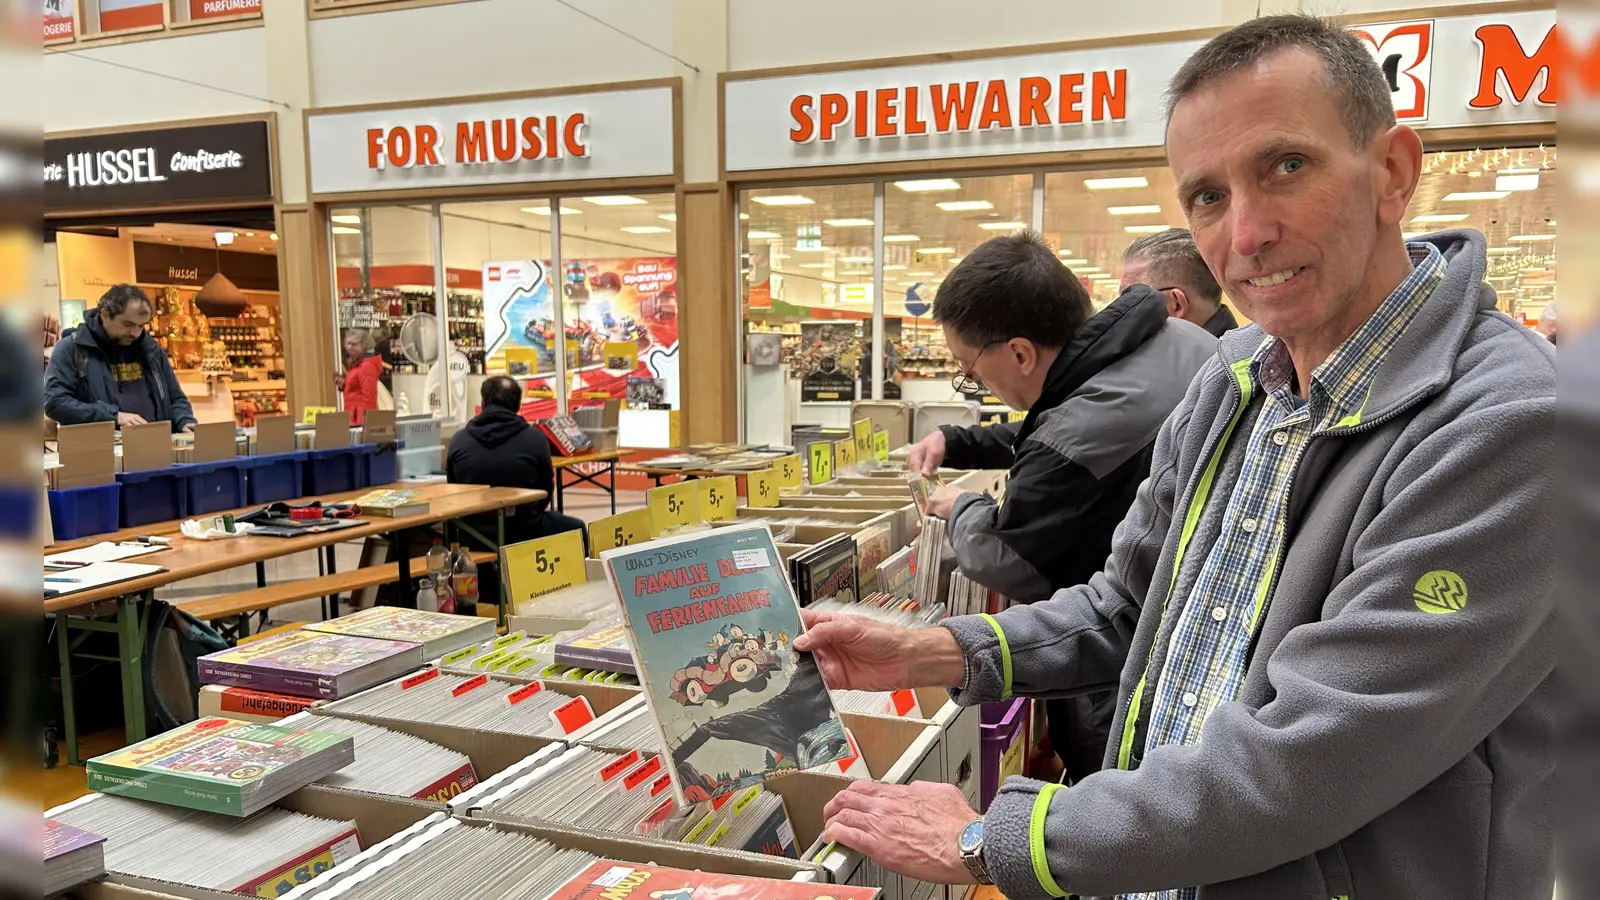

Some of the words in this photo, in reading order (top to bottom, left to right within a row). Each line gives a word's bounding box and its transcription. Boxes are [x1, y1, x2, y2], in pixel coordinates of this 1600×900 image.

[789, 68, 1128, 143] SPIELWAREN
[367, 124, 440, 169] FOR
[456, 112, 590, 163] MUSIC
[67, 147, 165, 188] HUSSEL
[170, 150, 243, 173] Confiserie
[168, 265, 198, 280] Hussel
[783, 463, 794, 479] 5,-
[814, 451, 829, 477] 7,-
[709, 488, 724, 509] 5,-
[759, 479, 771, 498] 5,-
[668, 493, 684, 514] 5,-
[535, 548, 561, 576] 5,-
[625, 556, 654, 571] WALT
[657, 548, 699, 565] DISNEY
[635, 562, 709, 597] FAMILIE
[690, 583, 720, 599] AUF
[646, 589, 772, 635] FERIENFAHRT
[242, 697, 309, 714] ruchgefahr!
